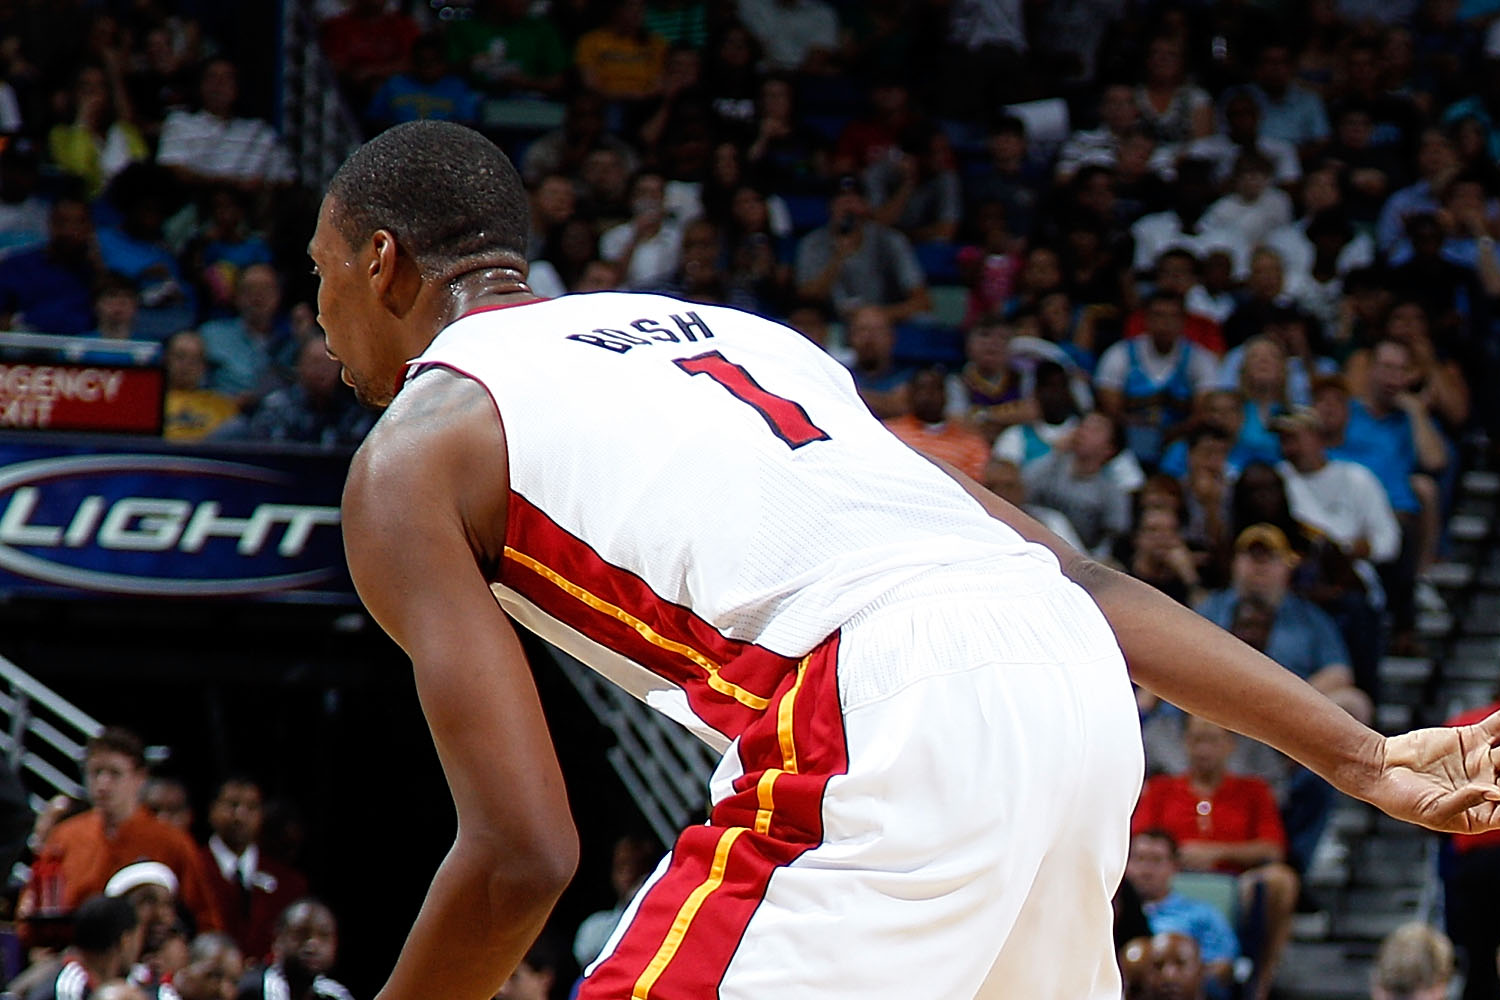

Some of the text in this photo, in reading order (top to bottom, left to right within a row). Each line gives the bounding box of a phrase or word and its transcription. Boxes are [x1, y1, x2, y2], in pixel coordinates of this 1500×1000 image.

[565, 310, 715, 354] BOSH
[671, 349, 833, 451] 1
[0, 485, 342, 556] LIGHT
